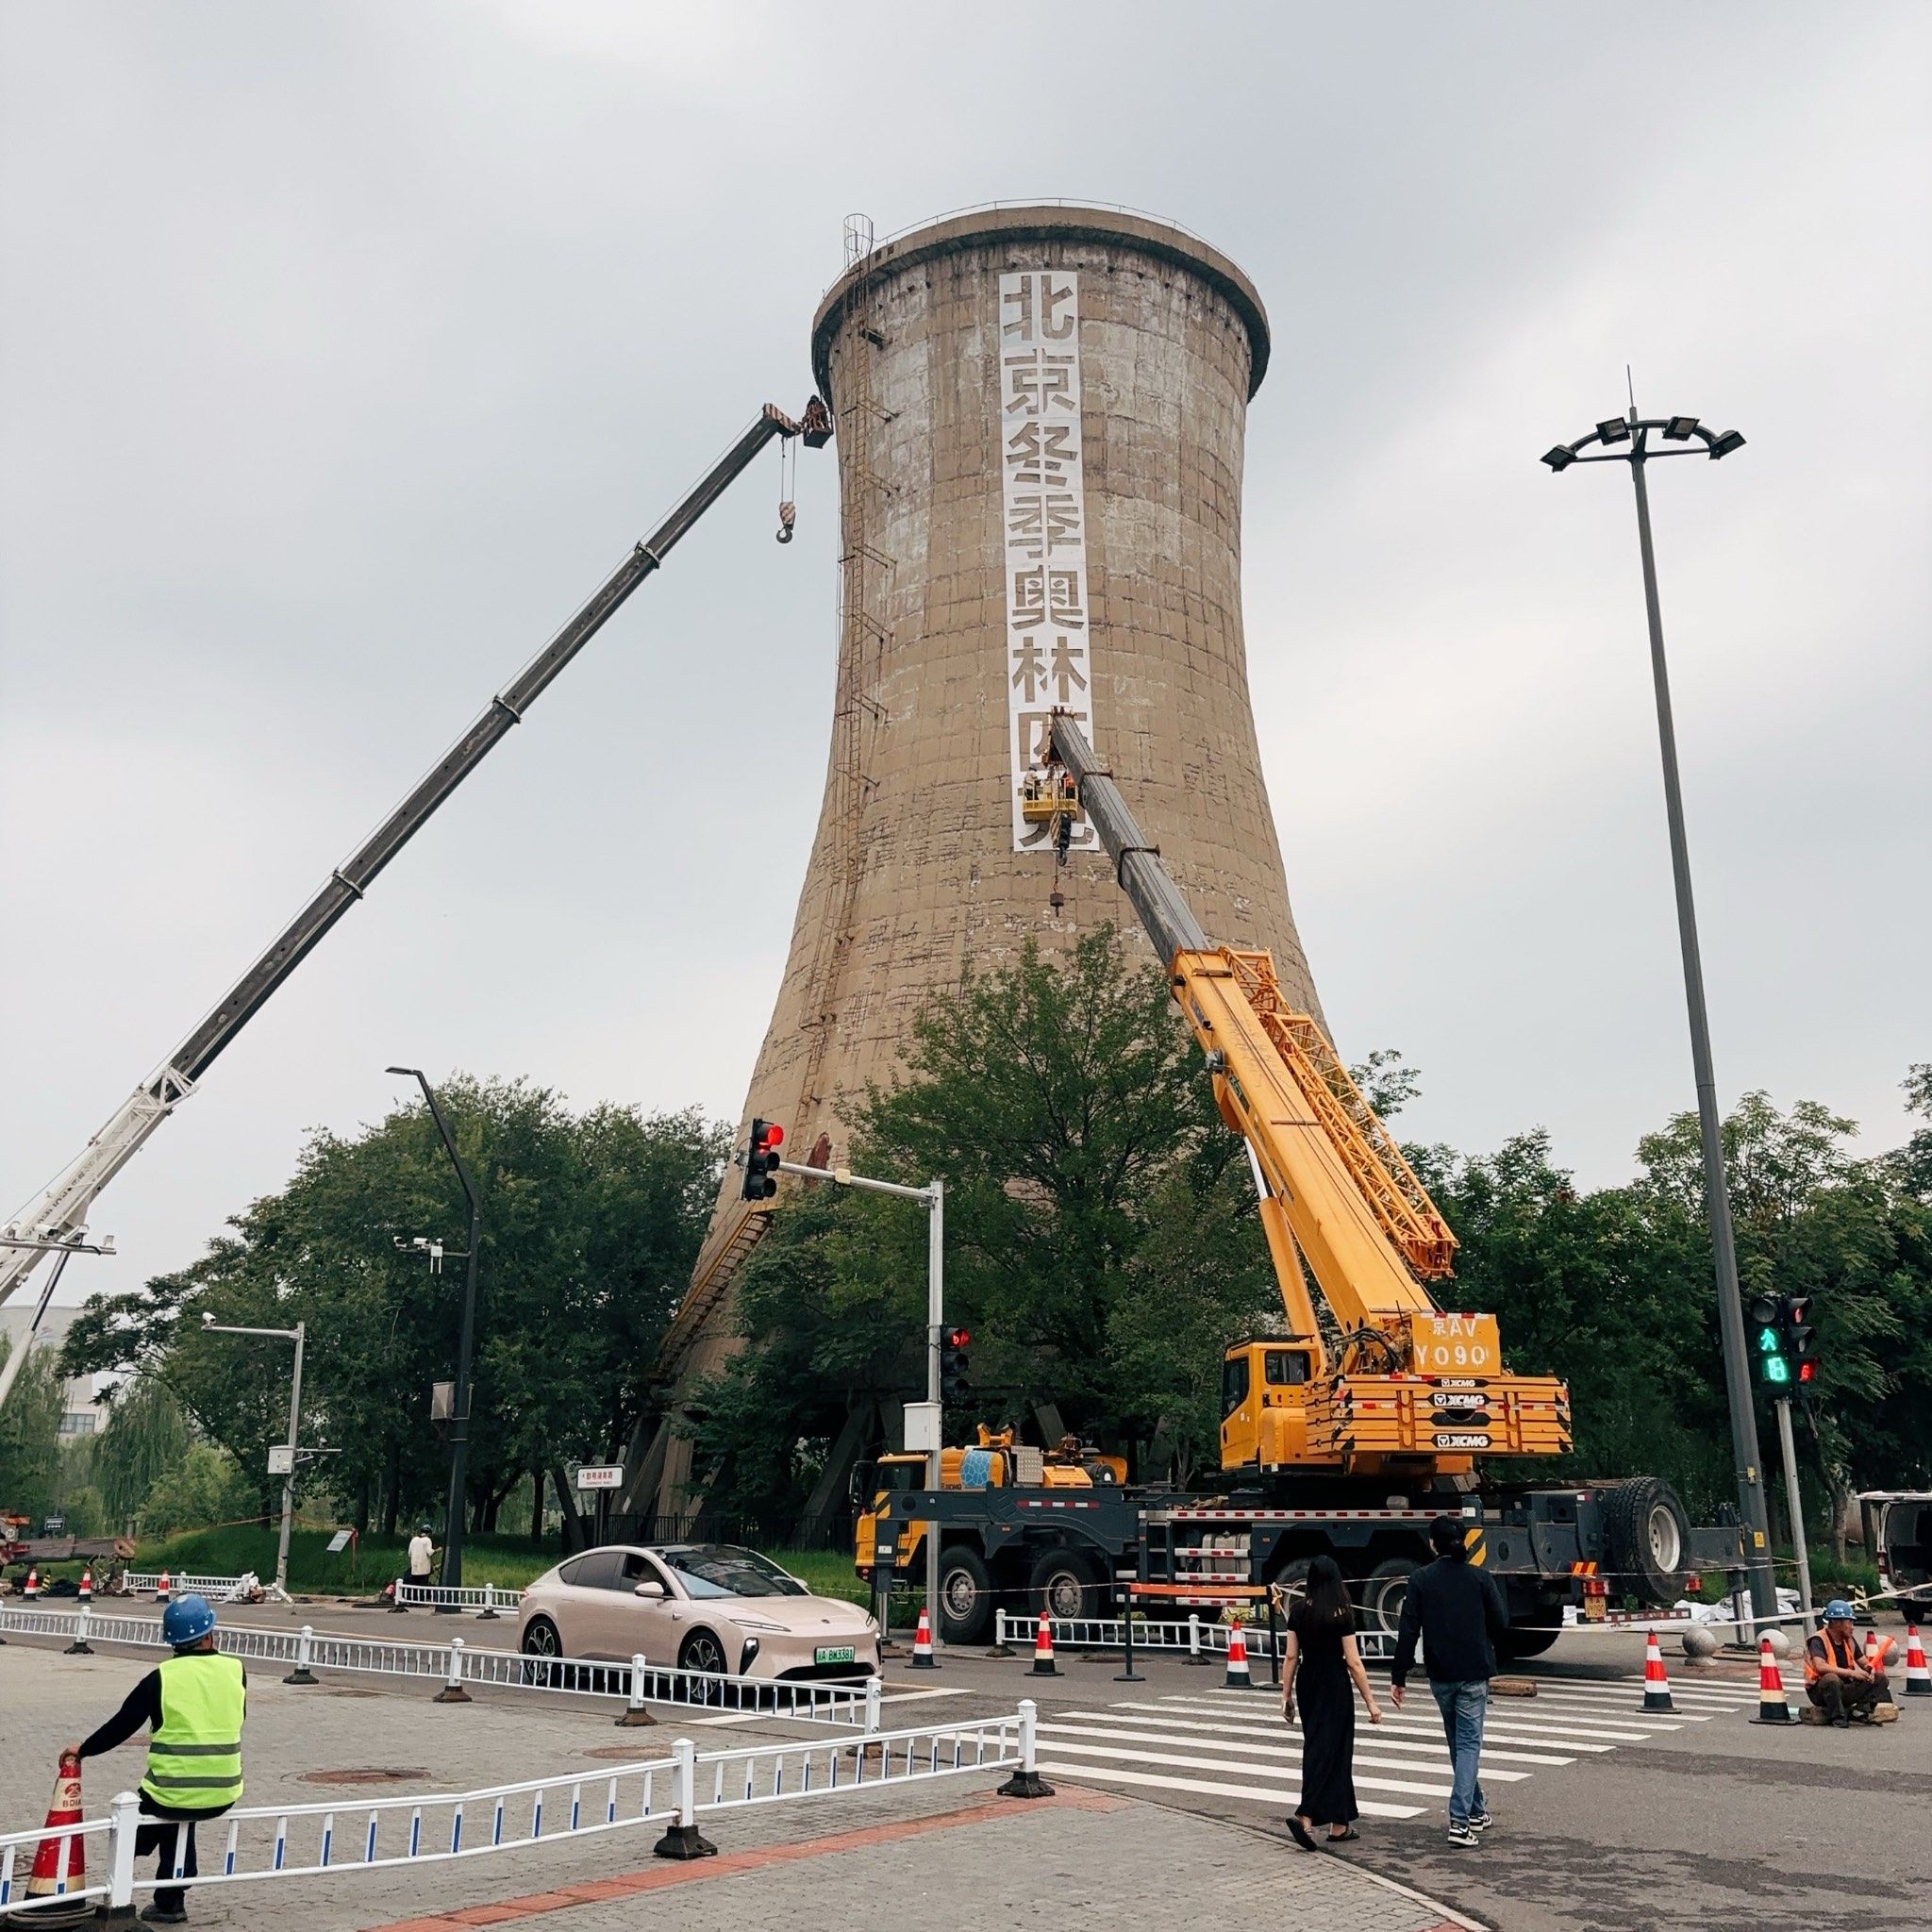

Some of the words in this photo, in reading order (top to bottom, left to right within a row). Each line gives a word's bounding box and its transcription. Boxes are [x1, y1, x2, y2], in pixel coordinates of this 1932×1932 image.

[1431, 1318, 1476, 1338] 京AV
[1446, 1394, 1485, 1406] XCMG
[1450, 1435, 1489, 1447] XCMG
